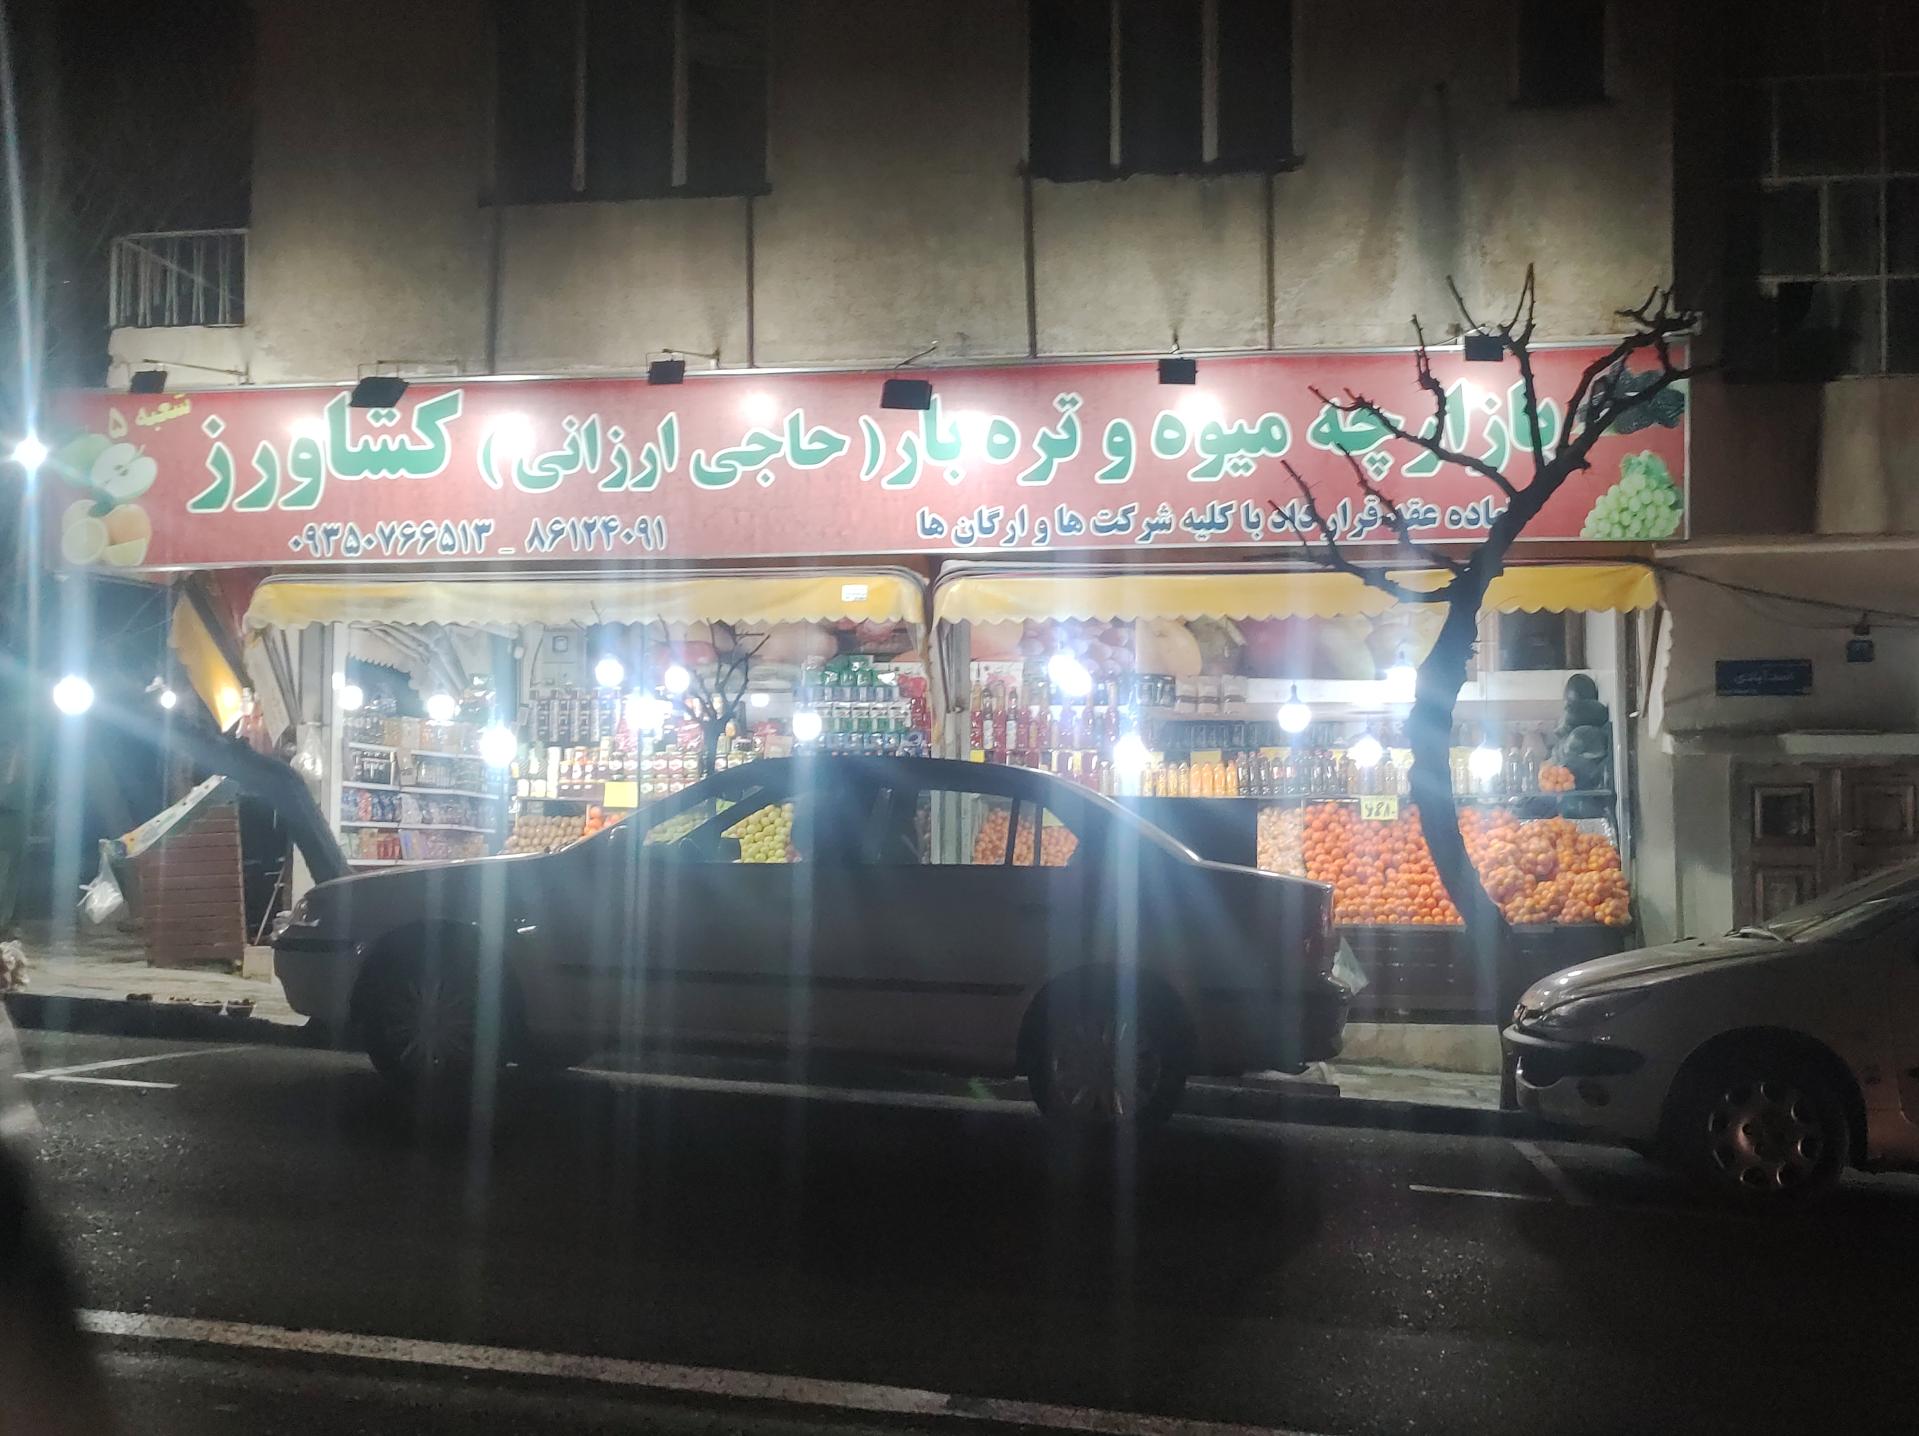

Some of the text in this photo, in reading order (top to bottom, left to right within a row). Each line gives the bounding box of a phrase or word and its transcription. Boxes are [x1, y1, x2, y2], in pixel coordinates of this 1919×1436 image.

[108, 393, 192, 440] شعبه ۵
[984, 392, 1083, 486] تره
[1306, 378, 1559, 482] بازارچه
[186, 388, 464, 514] کشاورز
[1096, 415, 1137, 483] و
[1152, 409, 1291, 482] میوه
[288, 518, 494, 558] ۰۹۳۵۰۷۶۶۵۱۳
[525, 515, 669, 553] ۸۶۱۲۴۰۹۱
[1032, 516, 1051, 547] و
[1180, 499, 1235, 543] کلیه
[1239, 500, 1264, 541] با
